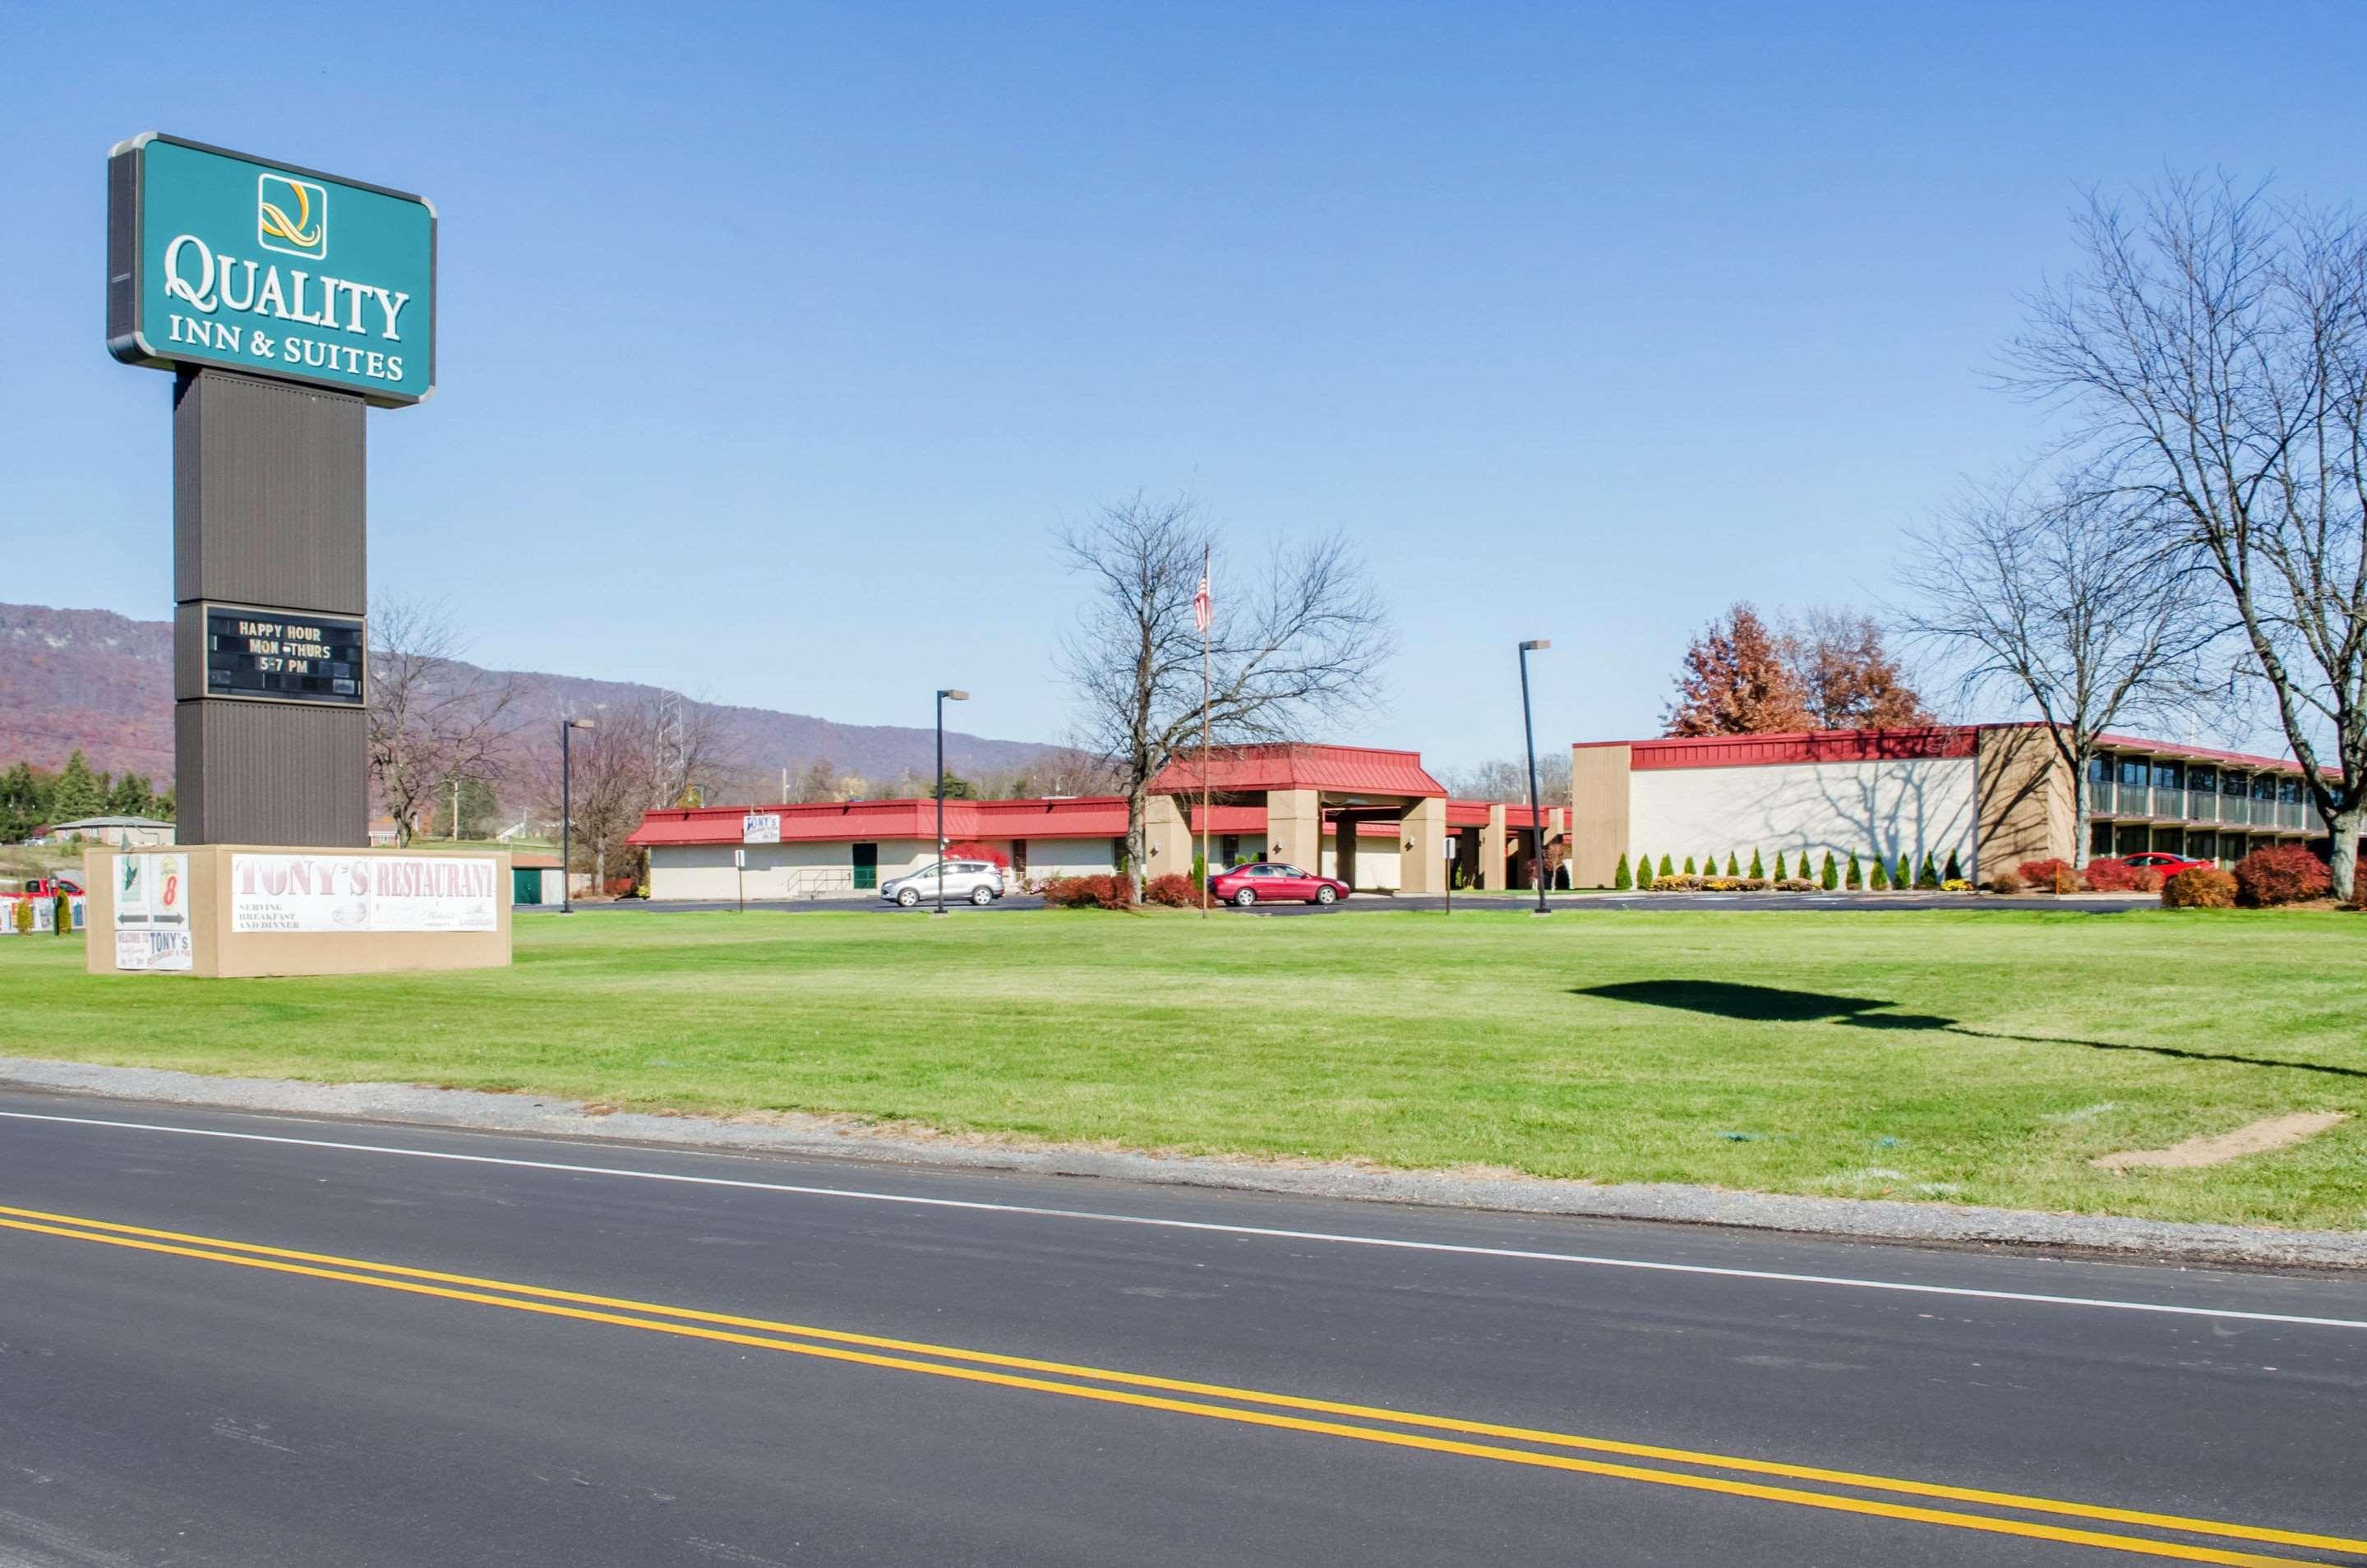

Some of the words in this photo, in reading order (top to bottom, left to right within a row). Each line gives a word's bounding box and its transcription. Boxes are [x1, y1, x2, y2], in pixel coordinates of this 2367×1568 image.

[164, 234, 410, 342] QUALITY
[168, 314, 242, 353] INN
[250, 330, 275, 358] &
[284, 337, 404, 382] SUITES
[238, 621, 283, 638] HAPPY
[288, 625, 321, 642] HOUR
[249, 639, 279, 654] MON
[260, 657, 283, 671] 5-7
[288, 660, 308, 674] PM
[163, 875, 178, 906] 8
[236, 860, 368, 896] TONY'S
[376, 862, 494, 898] RESTAURANT
[238, 903, 283, 911] SERVING
